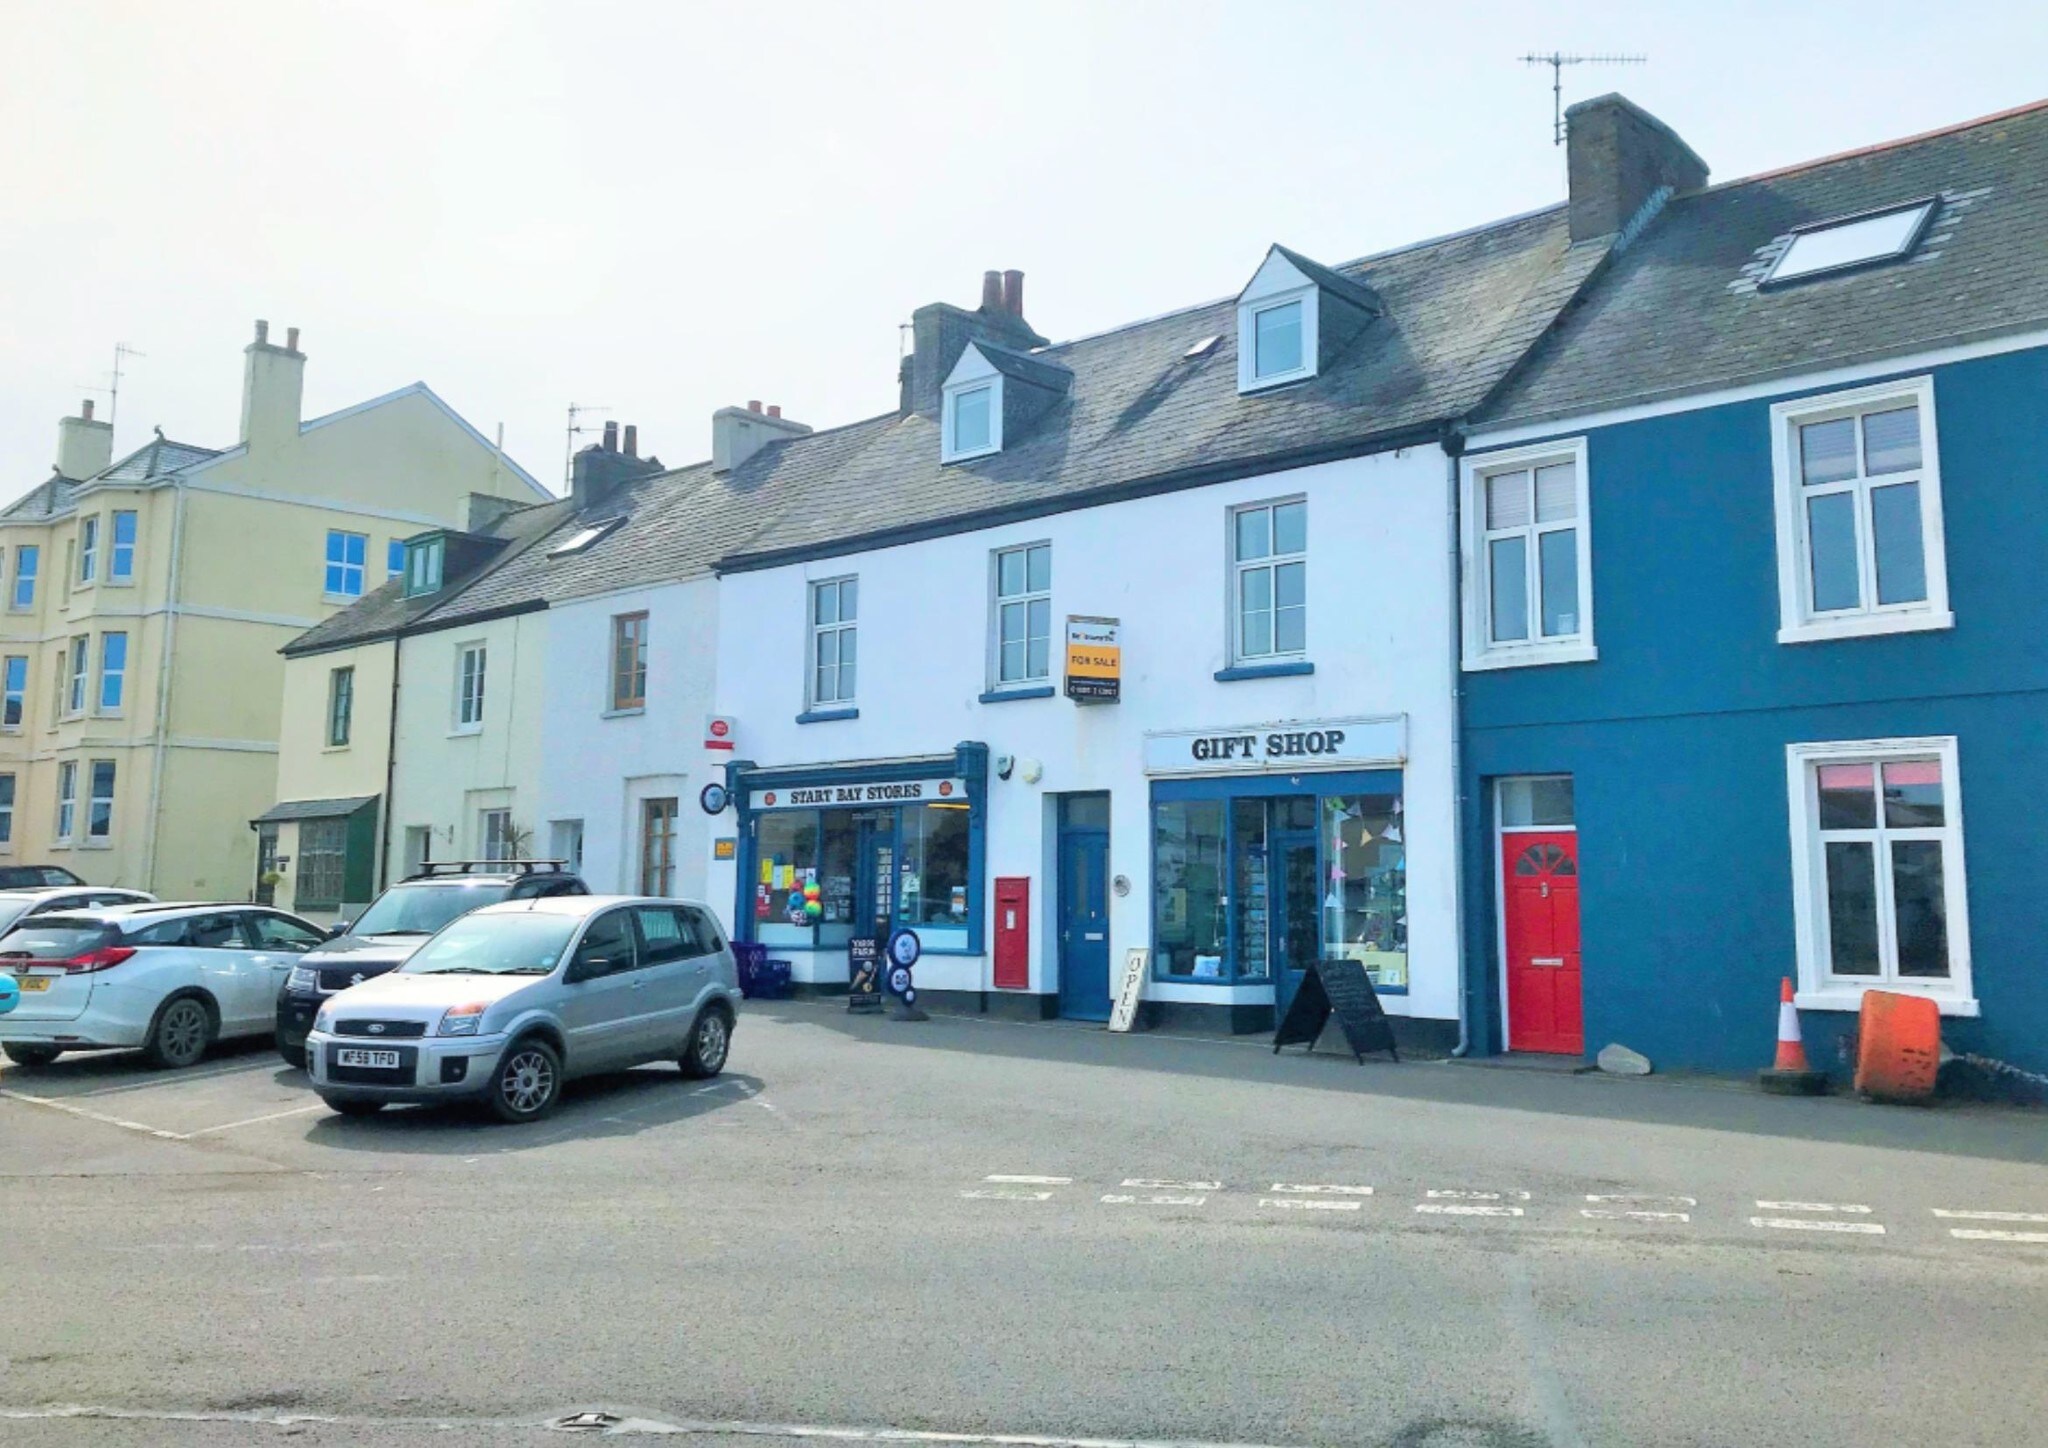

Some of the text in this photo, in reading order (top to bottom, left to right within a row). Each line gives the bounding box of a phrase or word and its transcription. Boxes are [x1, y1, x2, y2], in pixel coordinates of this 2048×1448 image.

[1093, 657, 1117, 668] SALE
[1191, 730, 1346, 761] GIFT SHOP
[790, 788, 833, 805] START
[836, 787, 863, 802] BAY
[867, 783, 922, 801] STORES
